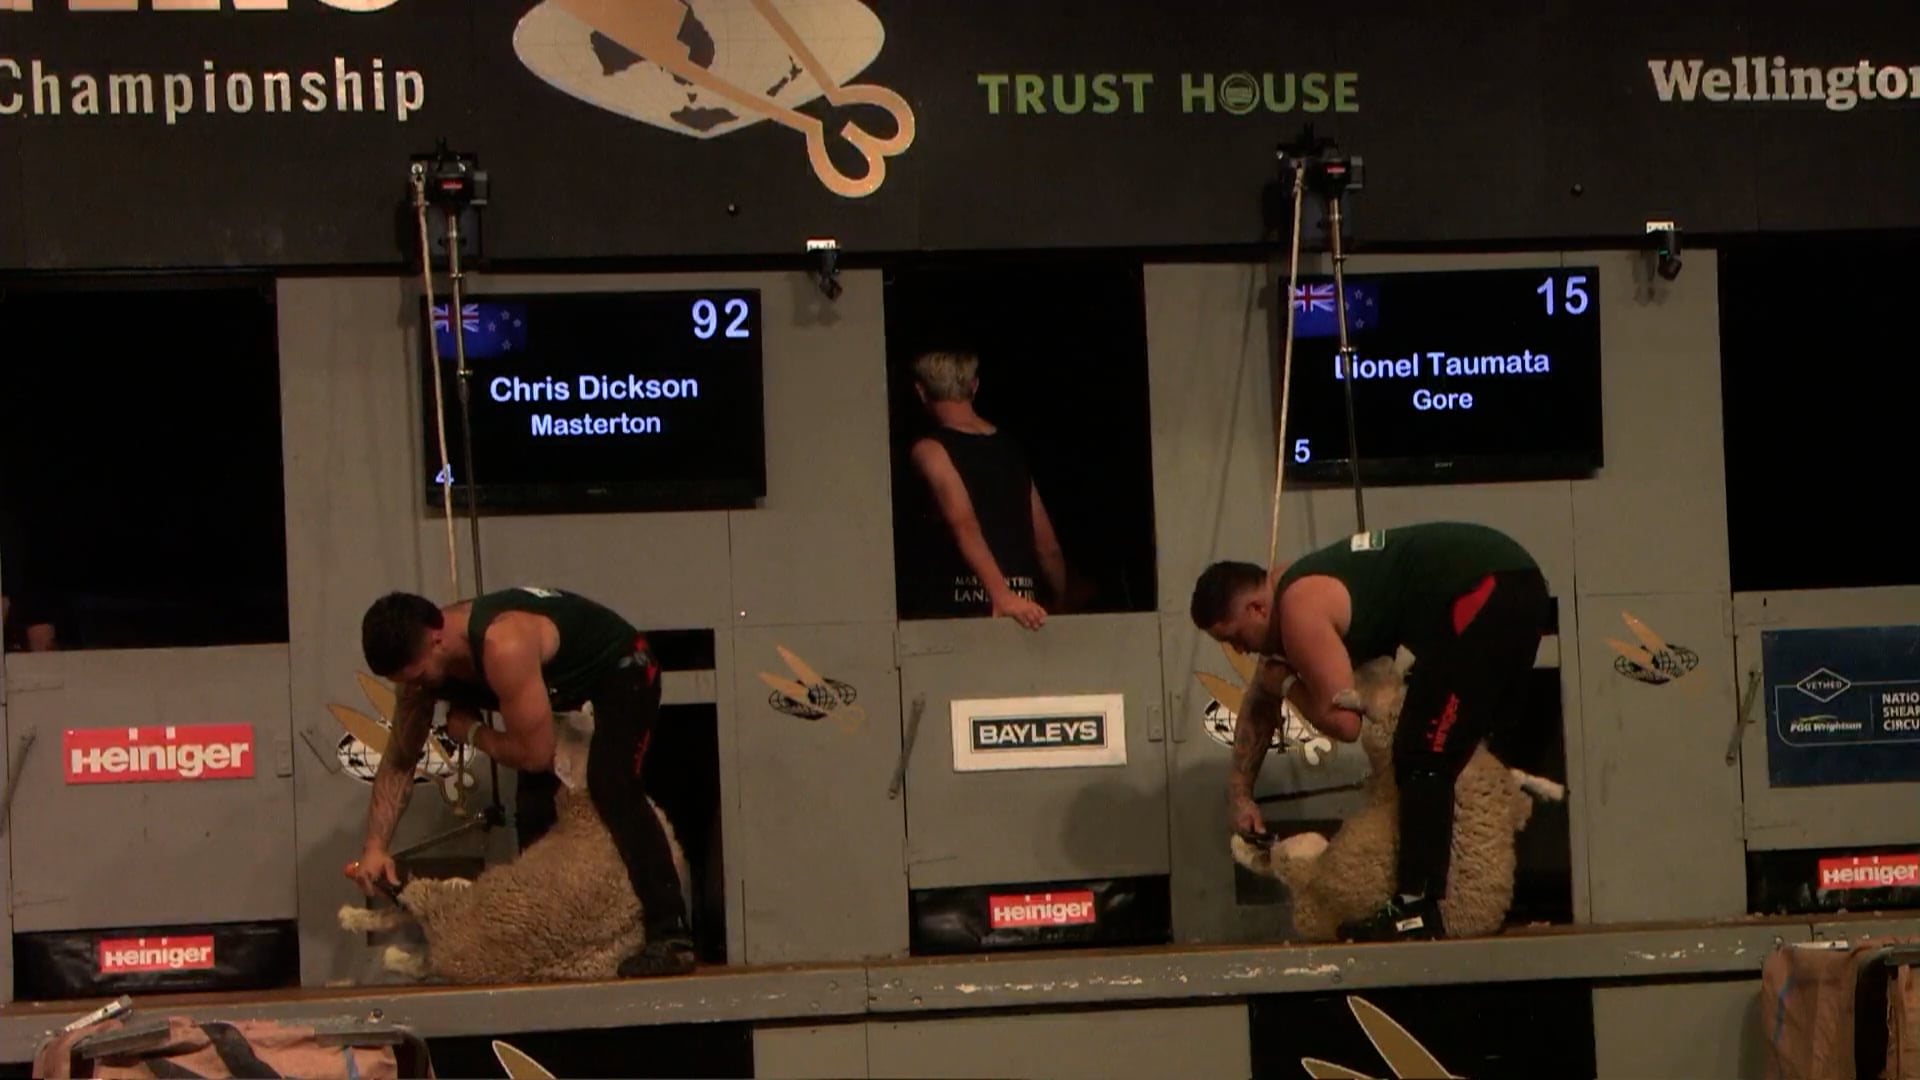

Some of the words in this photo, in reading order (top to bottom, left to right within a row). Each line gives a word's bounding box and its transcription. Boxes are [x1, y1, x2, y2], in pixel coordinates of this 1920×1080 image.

[0, 56, 425, 125] Championship
[976, 72, 1155, 115] TRUST
[1180, 71, 1360, 116] HOUSE
[1536, 275, 1589, 316] 15
[691, 298, 750, 340] 92
[1334, 351, 1420, 380] Lionel
[1426, 349, 1551, 377] Taumata
[489, 374, 571, 402] Chris
[578, 373, 699, 401] Dickson
[1412, 388, 1474, 411] Gore
[530, 412, 662, 436] Masterton
[1294, 438, 1311, 464] 5
[979, 720, 1098, 745] BAYLEYS
[71, 726, 250, 778] Heiniger
[1822, 855, 1919, 885] Heiniger
[993, 893, 1093, 923] Heiniger
[104, 937, 212, 968] Heiniger
